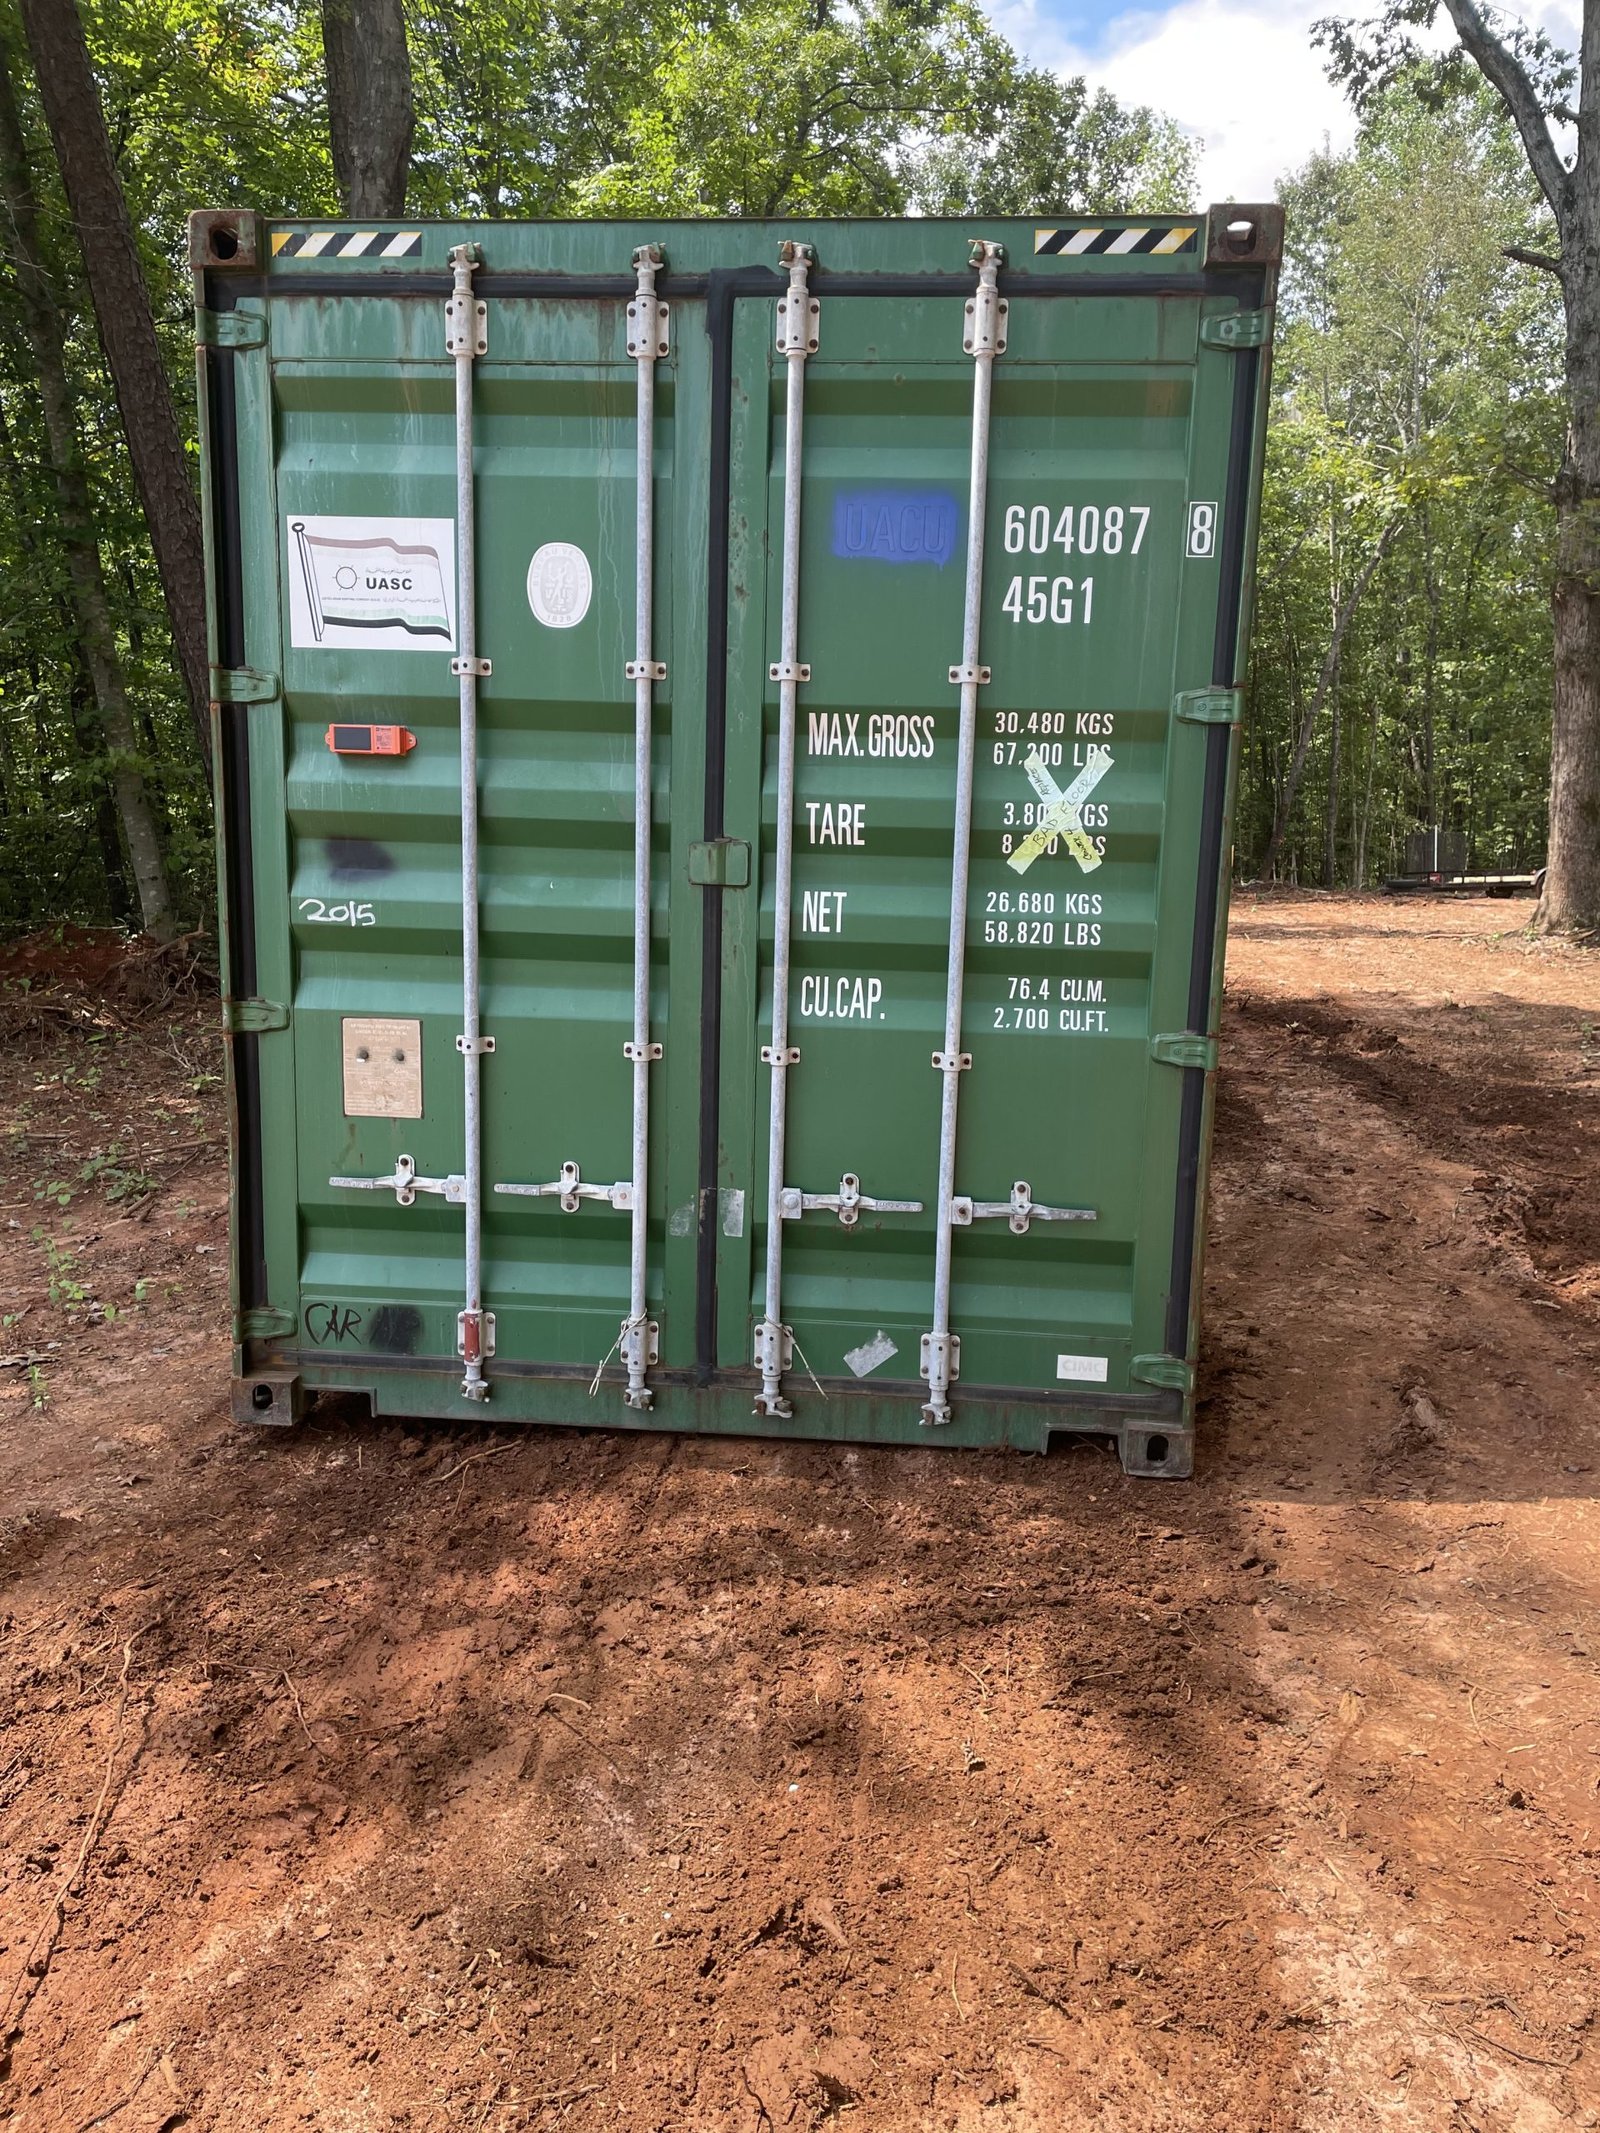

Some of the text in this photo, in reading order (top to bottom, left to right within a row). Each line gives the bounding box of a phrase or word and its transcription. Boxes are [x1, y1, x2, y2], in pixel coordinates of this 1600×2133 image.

[845, 503, 946, 553] UACU
[1004, 504, 1214, 555] 604087 8
[366, 577, 413, 590] UASC
[1002, 576, 1094, 624] 45G1
[995, 712, 1114, 735] 30,480 KGS
[805, 802, 866, 846] TARE
[1003, 802, 1049, 826] 3,80
[1032, 818, 1058, 847] BAD
[1060, 778, 1096, 815] FLOOR
[298, 898, 376, 927] 2015
[802, 890, 848, 933] NET
[986, 891, 1103, 915] 26,680 KGS
[984, 920, 1102, 946] 58,820 LBS
[800, 975, 886, 1020] CU.CAP.
[1007, 977, 1107, 1003] 76.4 CU.M.
[993, 1007, 1109, 1032] 2,700 CU.FT.
[304, 1302, 362, 1345] CAR
